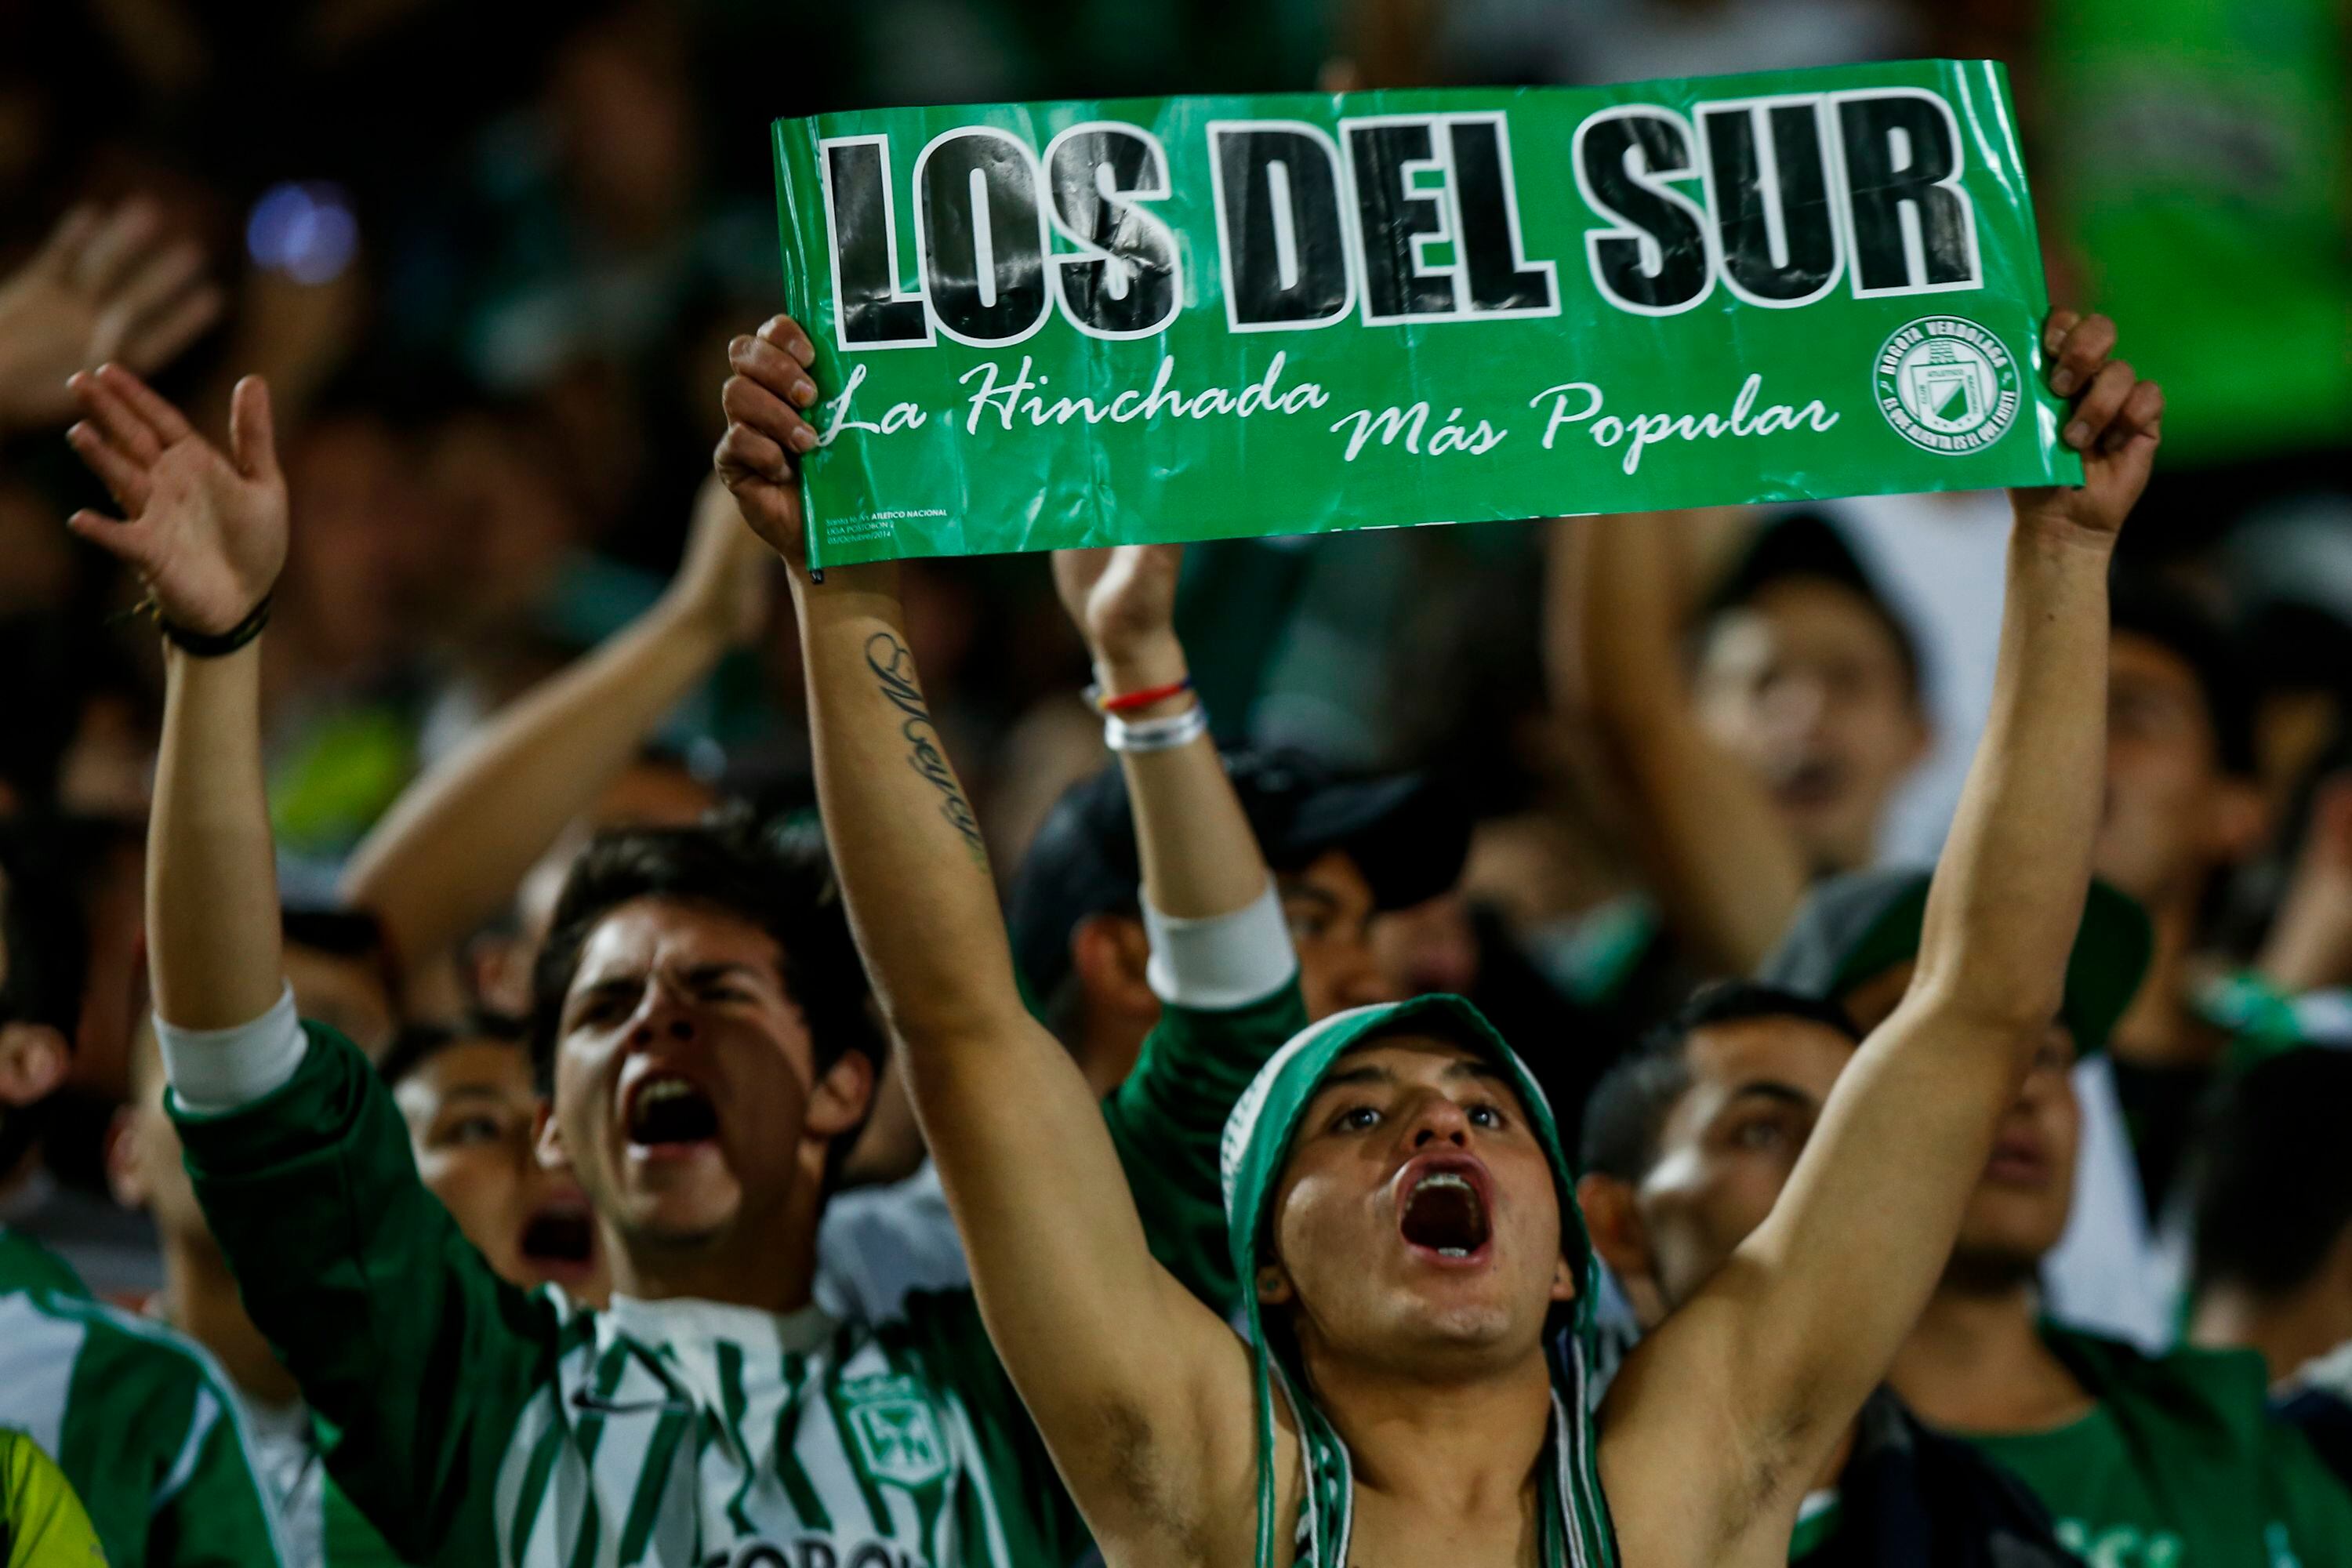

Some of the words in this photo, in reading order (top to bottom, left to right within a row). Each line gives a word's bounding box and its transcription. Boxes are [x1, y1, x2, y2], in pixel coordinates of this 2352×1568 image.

[818, 119, 1183, 352] LOS
[1205, 110, 1561, 334] DEL
[1572, 86, 1984, 317] SUR
[815, 364, 927, 447] La
[959, 350, 1330, 435] Hinchada
[1330, 404, 1508, 462] Más
[1530, 373, 1840, 475] Popular
[871, 510, 906, 521] ATLETICO
[906, 509, 948, 518] NACIONAL
